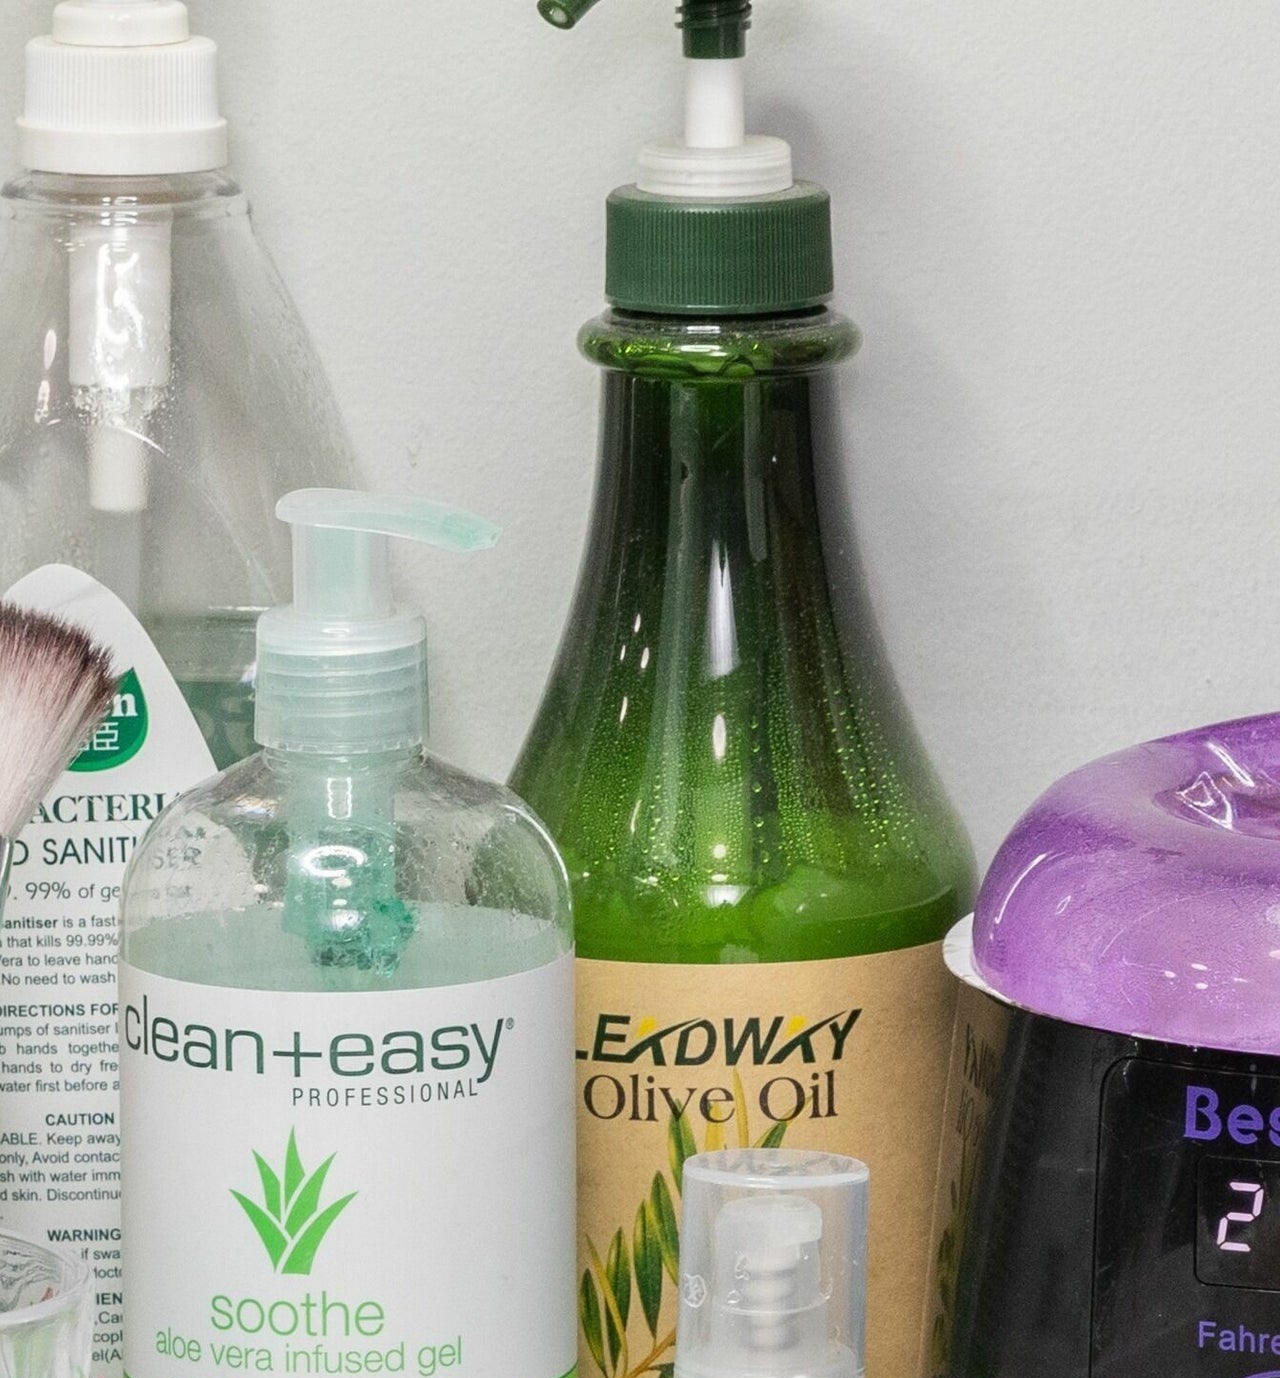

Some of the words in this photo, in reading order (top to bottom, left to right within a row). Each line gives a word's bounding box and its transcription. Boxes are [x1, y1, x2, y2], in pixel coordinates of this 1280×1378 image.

[78, 882, 95, 898] of
[1, 917, 58, 929] anitiser
[62, 916, 74, 928] is
[78, 919, 87, 928] a
[7, 936, 32, 948] that
[36, 935, 62, 947] kills
[66, 933, 119, 947] 99.99%
[27, 955, 40, 966] to
[44, 954, 81, 965] leave
[24, 973, 58, 985] need
[62, 973, 76, 985] to
[79, 971, 116, 984] wash
[36, 1023, 49, 1036] of
[53, 1022, 110, 1036] sanitiser
[575, 1008, 863, 1066] EADWAY
[16, 1042, 58, 1055] hands
[2, 1061, 42, 1074] hands
[50, 1061, 63, 1074] to
[70, 1061, 92, 1075] dry
[35, 1077, 61, 1092] first
[65, 1076, 108, 1091] before
[293, 1077, 478, 1107] PROFESSIONAL
[583, 1074, 735, 1123] Olive
[759, 1069, 839, 1123] Oil
[45, 1112, 115, 1126] CAUTION
[47, 1133, 82, 1147] Keep
[32, 1152, 70, 1163] Avoid
[19, 1170, 46, 1182] with
[50, 1171, 87, 1182] water
[12, 1188, 42, 1201] skin.
[210, 1291, 385, 1337] soothe
[155, 1327, 202, 1363] aloe
[210, 1342, 274, 1372] vera
[285, 1343, 406, 1374] infused
[416, 1335, 463, 1377] gel
